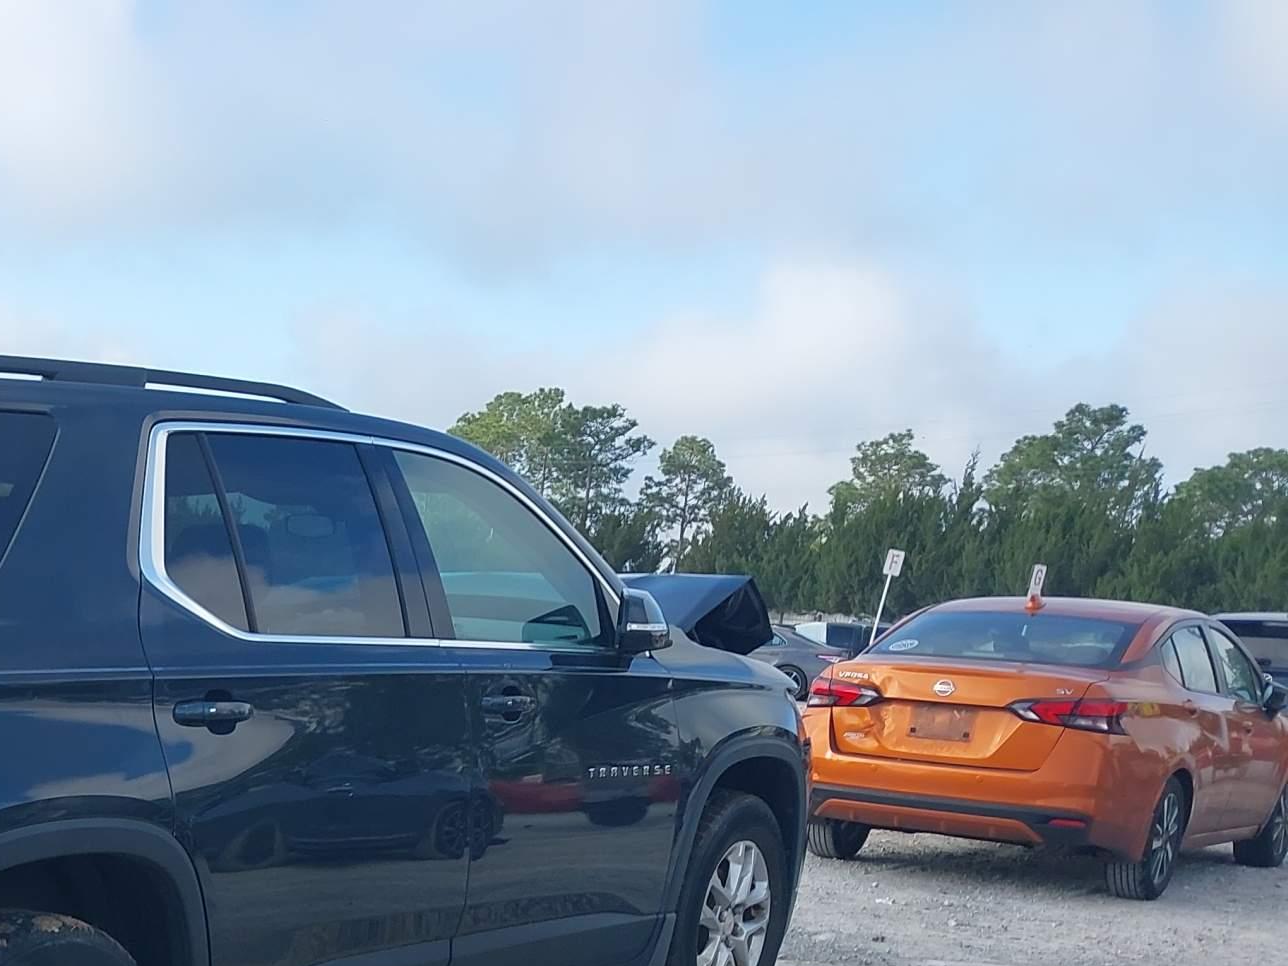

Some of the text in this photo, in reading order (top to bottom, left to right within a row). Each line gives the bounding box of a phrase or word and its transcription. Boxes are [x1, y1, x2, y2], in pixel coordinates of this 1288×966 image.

[890, 553, 900, 570] F
[1034, 569, 1043, 586] G
[588, 765, 671, 778] TRAVERSE
